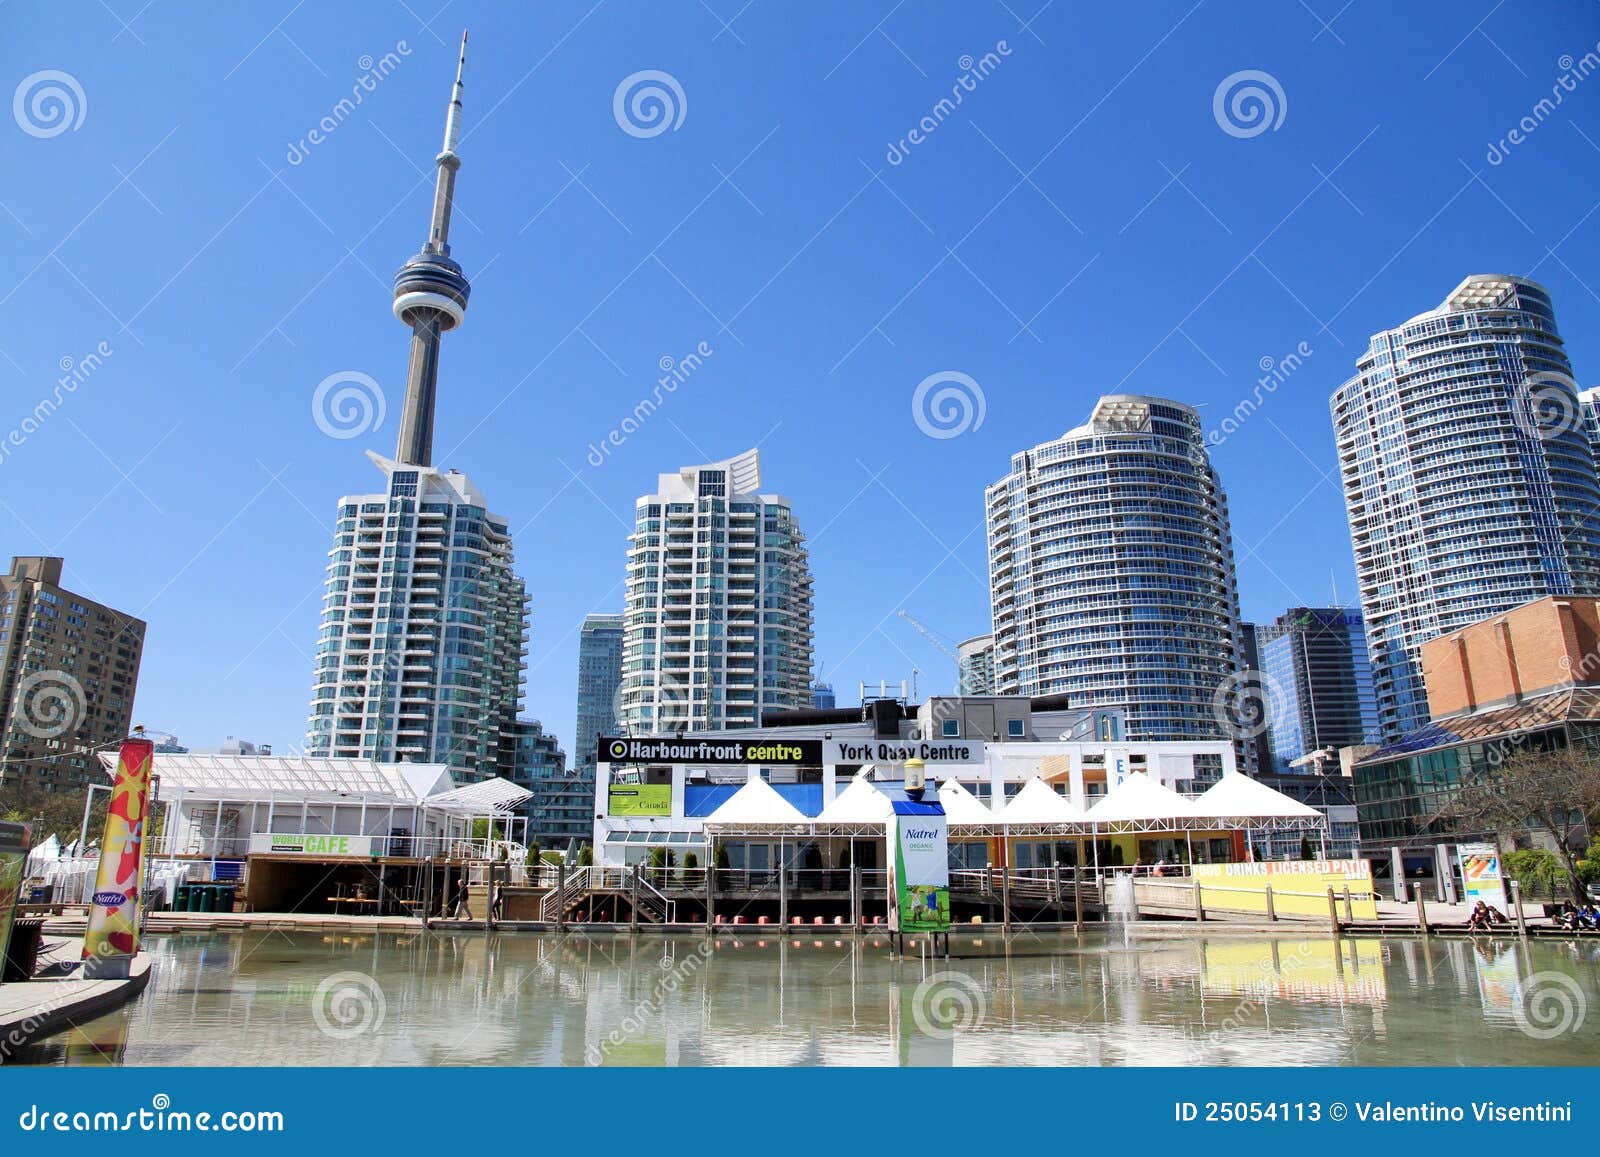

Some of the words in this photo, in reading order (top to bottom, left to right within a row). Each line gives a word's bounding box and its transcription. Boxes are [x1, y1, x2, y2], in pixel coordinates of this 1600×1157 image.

[629, 741, 743, 760] Harbourfront
[746, 743, 803, 760] centre
[839, 743, 873, 760] York
[878, 743, 915, 761] Quay
[920, 743, 970, 760] Centre
[638, 799, 668, 809] Canada
[905, 829, 938, 839] Natrel
[272, 835, 304, 844] WORLD
[305, 835, 349, 853] CAFE
[1226, 861, 1267, 876] DRINKS
[1272, 860, 1330, 874] LICENSED
[1333, 859, 1369, 873] PATIO
